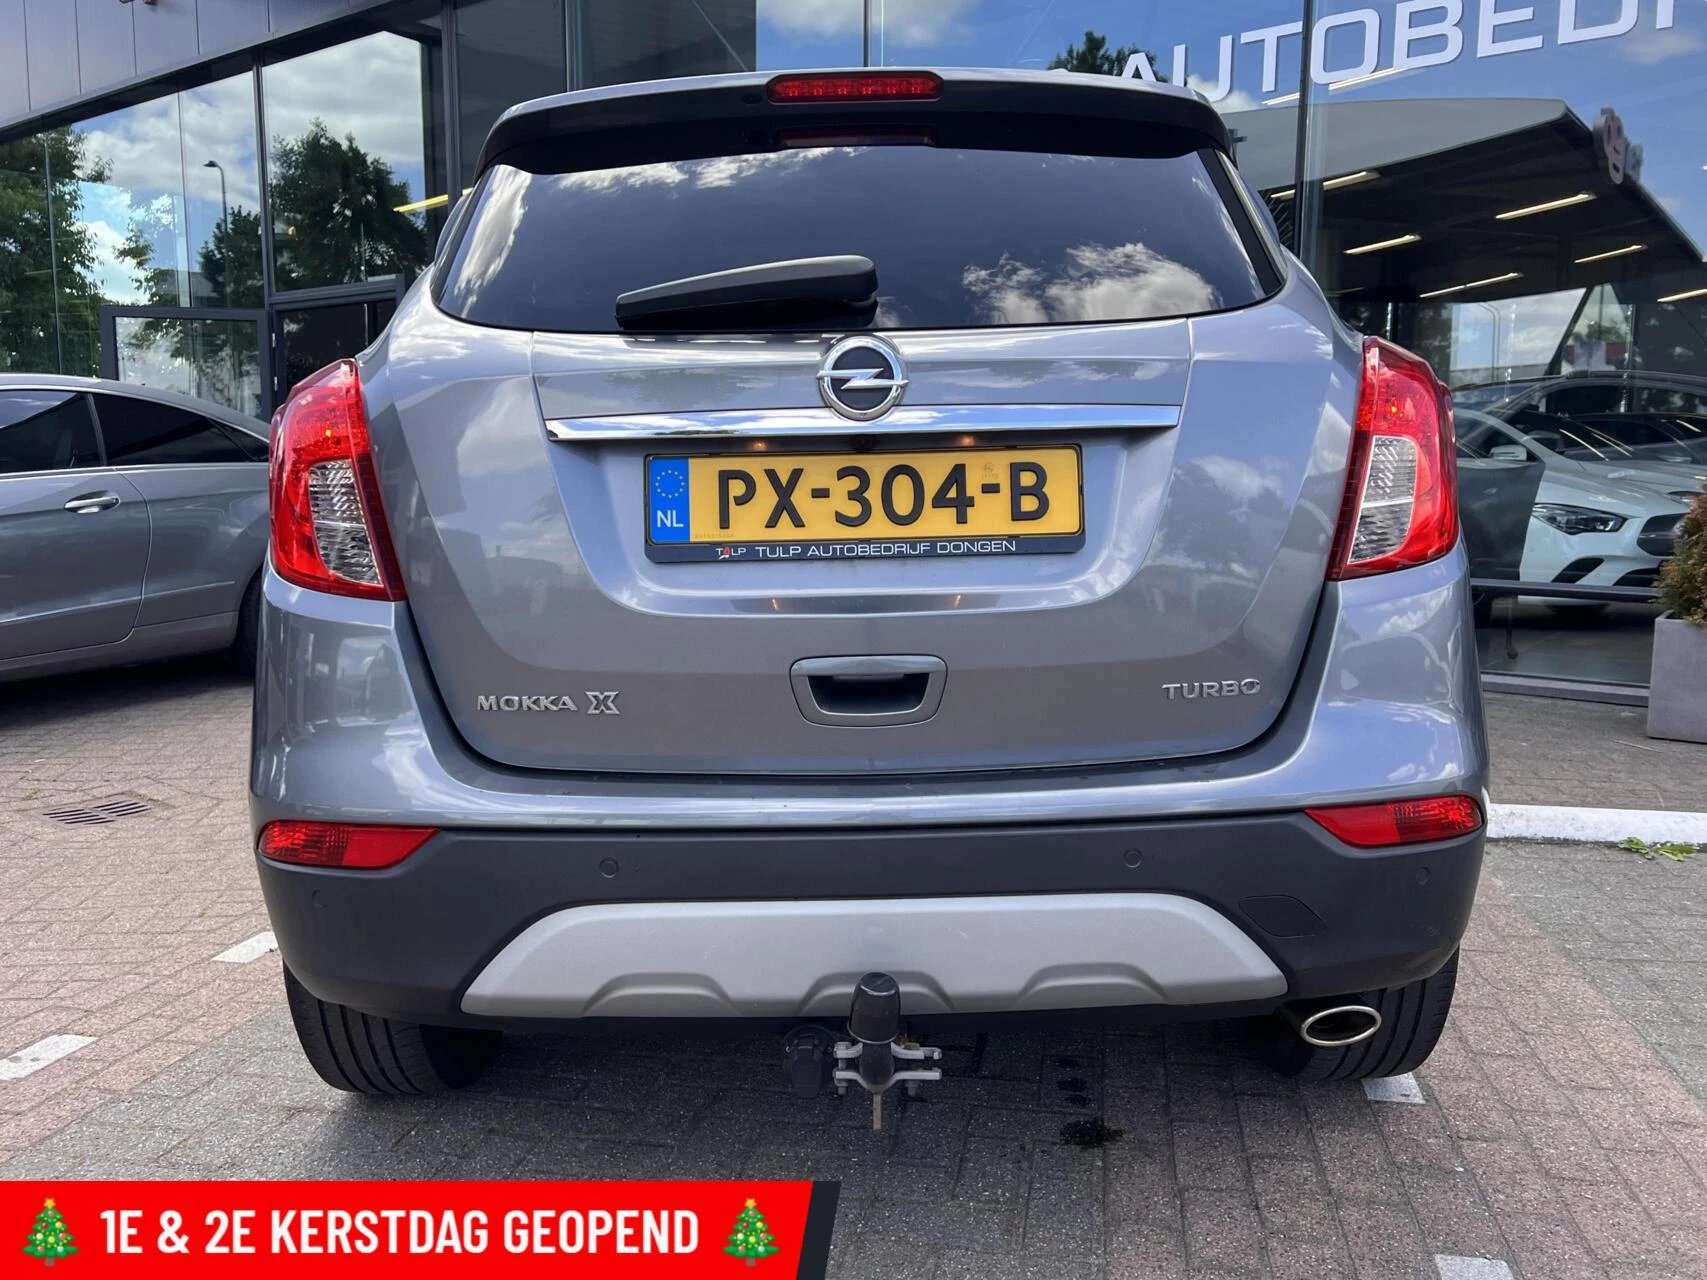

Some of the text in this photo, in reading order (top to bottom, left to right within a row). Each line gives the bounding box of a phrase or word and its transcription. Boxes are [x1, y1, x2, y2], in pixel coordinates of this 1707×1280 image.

[718, 461, 1050, 530] PX-304-B
[656, 509, 684, 528] NL
[755, 545, 801, 558] TULP
[807, 542, 931, 557] AUTOBEDRIJF
[937, 540, 1016, 554] DONGEN
[1161, 678, 1261, 700] TURBO
[476, 690, 621, 715] MOKKA X
